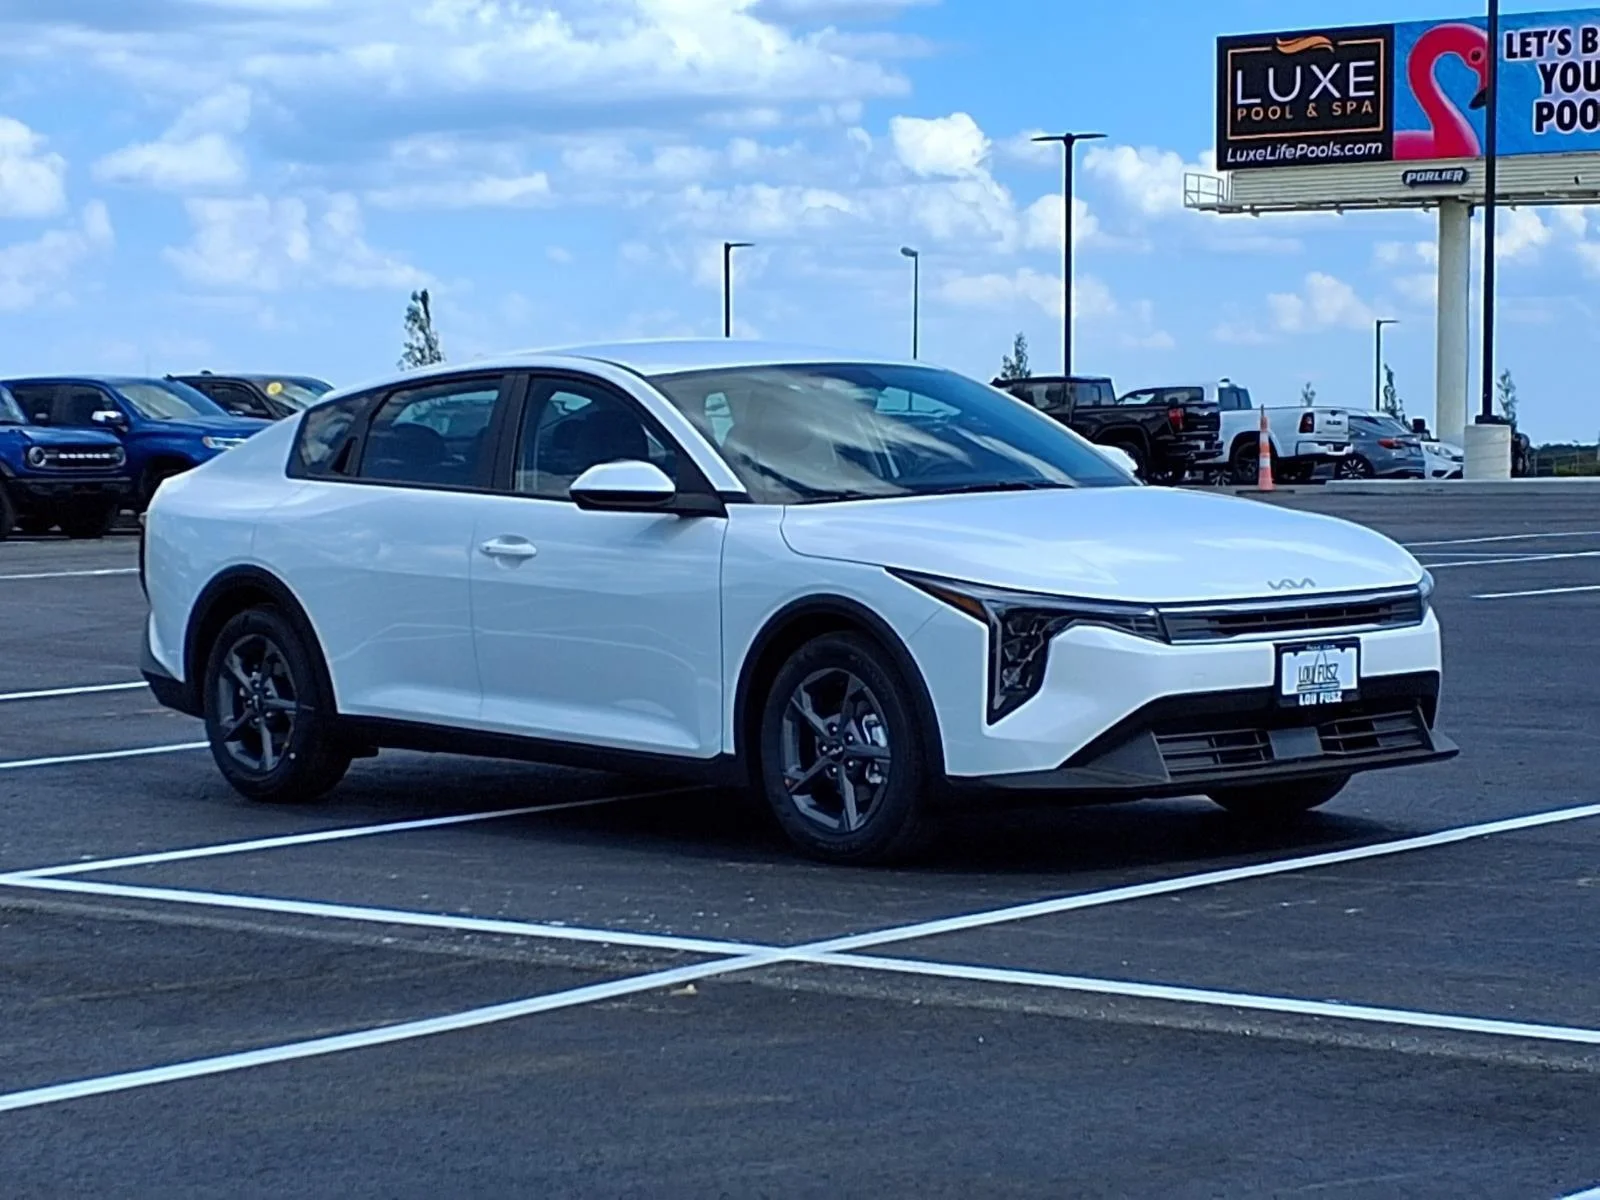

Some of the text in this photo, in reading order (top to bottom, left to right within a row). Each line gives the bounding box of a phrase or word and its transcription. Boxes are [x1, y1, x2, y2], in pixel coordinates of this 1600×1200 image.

[1505, 28, 1572, 59] LET'S
[1236, 60, 1376, 105] LUXE
[1236, 99, 1374, 122] POOL & SPA
[1535, 98, 1600, 133] POO
[1226, 140, 1383, 163] LuxeLifePools.com
[1405, 169, 1464, 185] PORLIER
[1299, 692, 1317, 706] LOU
